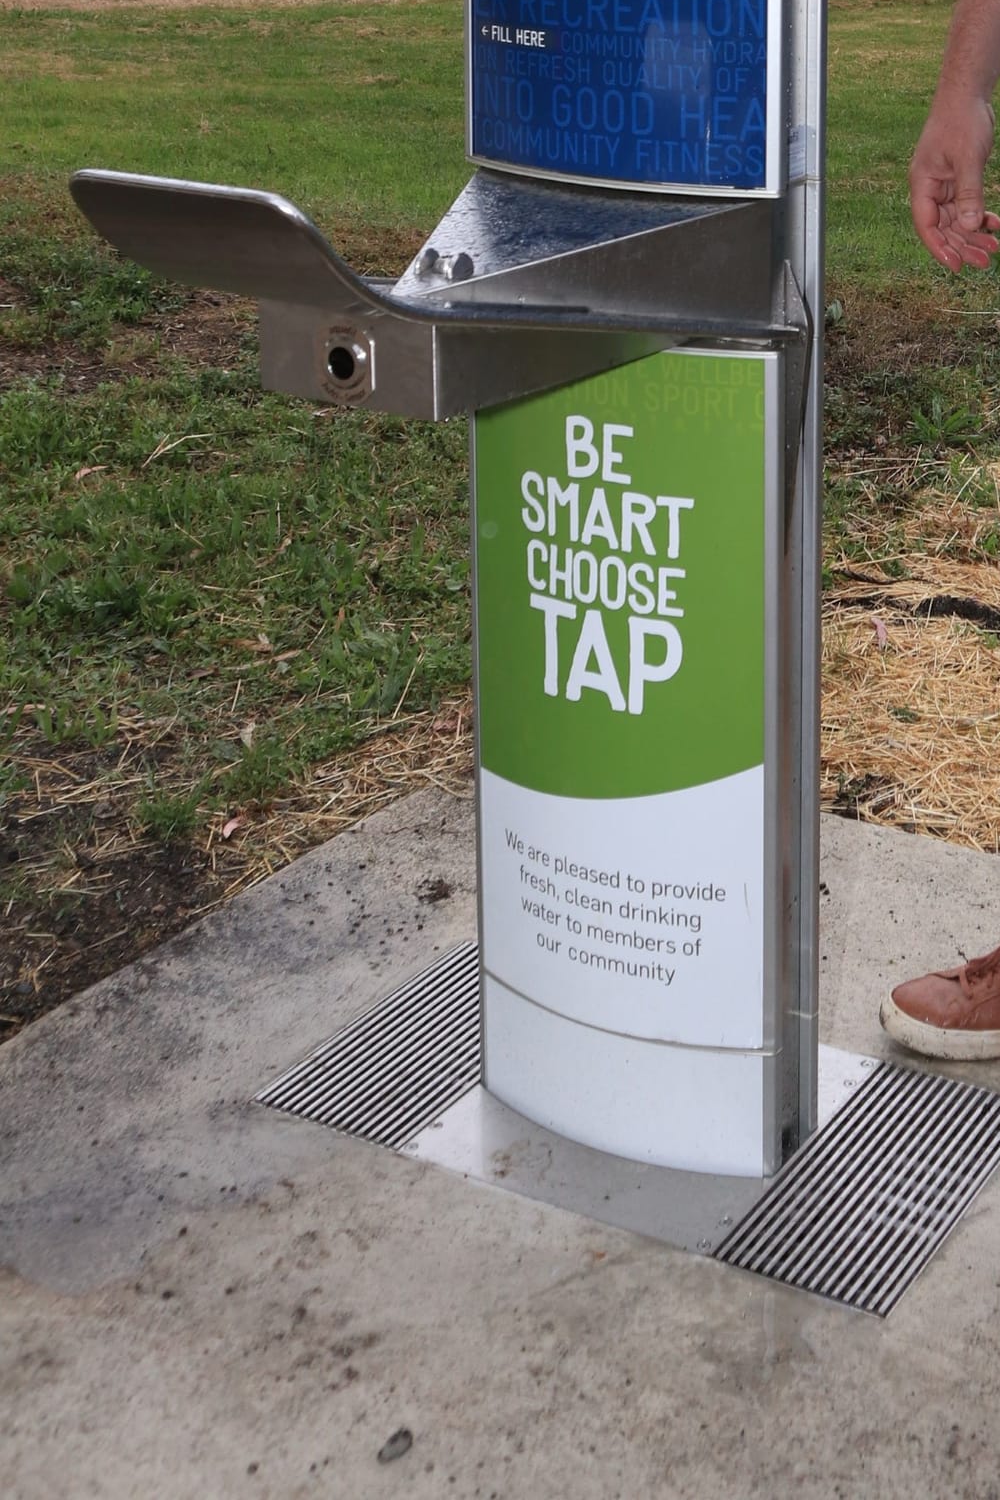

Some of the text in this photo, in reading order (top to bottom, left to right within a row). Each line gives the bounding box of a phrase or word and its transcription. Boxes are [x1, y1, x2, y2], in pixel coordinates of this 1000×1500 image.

[491, 25, 546, 48] FILL HERE
[560, 31, 681, 60] COMMUNITY
[505, 49, 591, 84] REFRESH
[602, 59, 703, 91] QUALITY
[716, 67, 750, 93] OF
[552, 83, 655, 136] GOOD
[481, 117, 621, 169] COMMUNITY
[635, 138, 764, 177] FITNESS
[565, 415, 633, 485] BE
[521, 470, 694, 559] SMART
[527, 539, 686, 618] CHOOSE
[530, 593, 683, 715] TAP
[505, 828, 726, 902] We are pleased to provide
[520, 864, 702, 932] fresh, clean drinking
[521, 897, 702, 956] water to members of
[536, 932, 676, 986] our community
